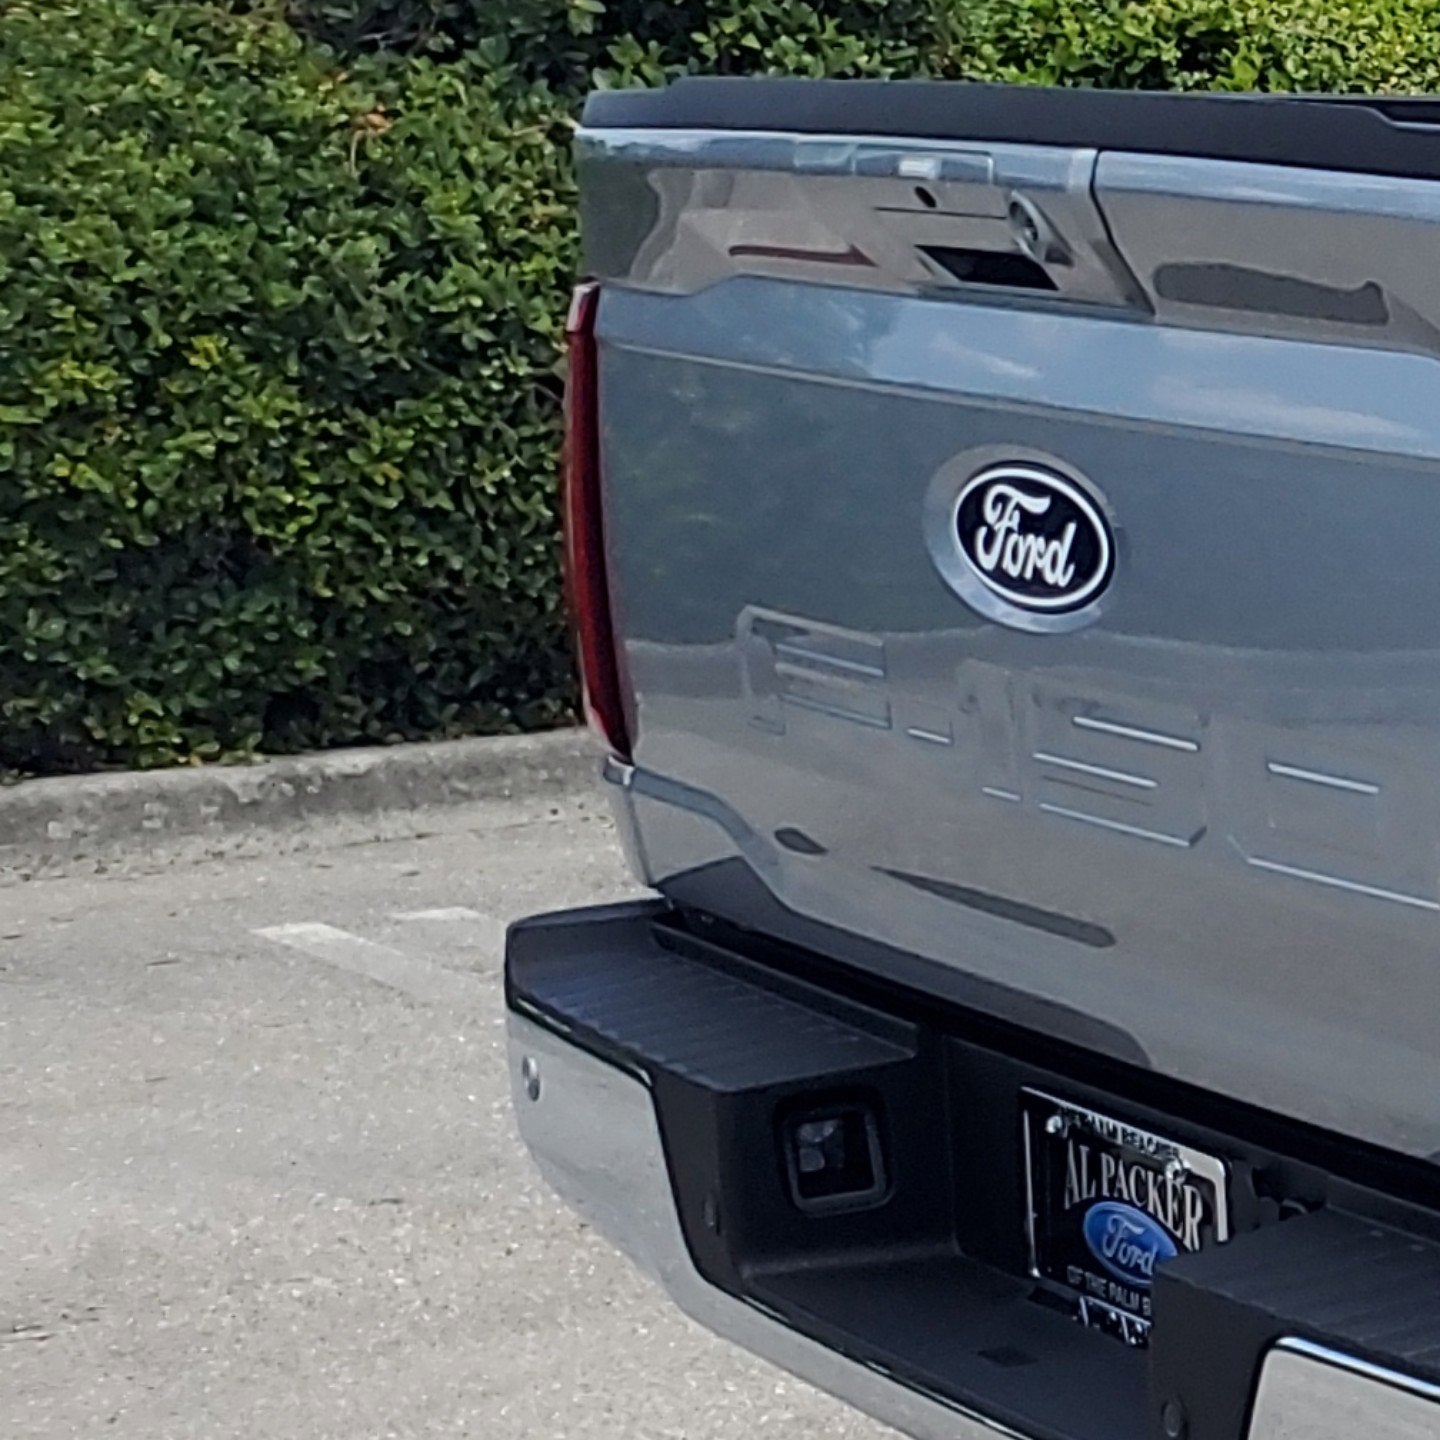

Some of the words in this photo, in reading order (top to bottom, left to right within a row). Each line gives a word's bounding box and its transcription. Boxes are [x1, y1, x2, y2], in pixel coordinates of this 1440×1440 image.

[974, 482, 1078, 588] Ford
[1064, 1138, 1096, 1210] AL
[1100, 1151, 1204, 1252] PACKER
[1102, 1214, 1156, 1276] Ford
